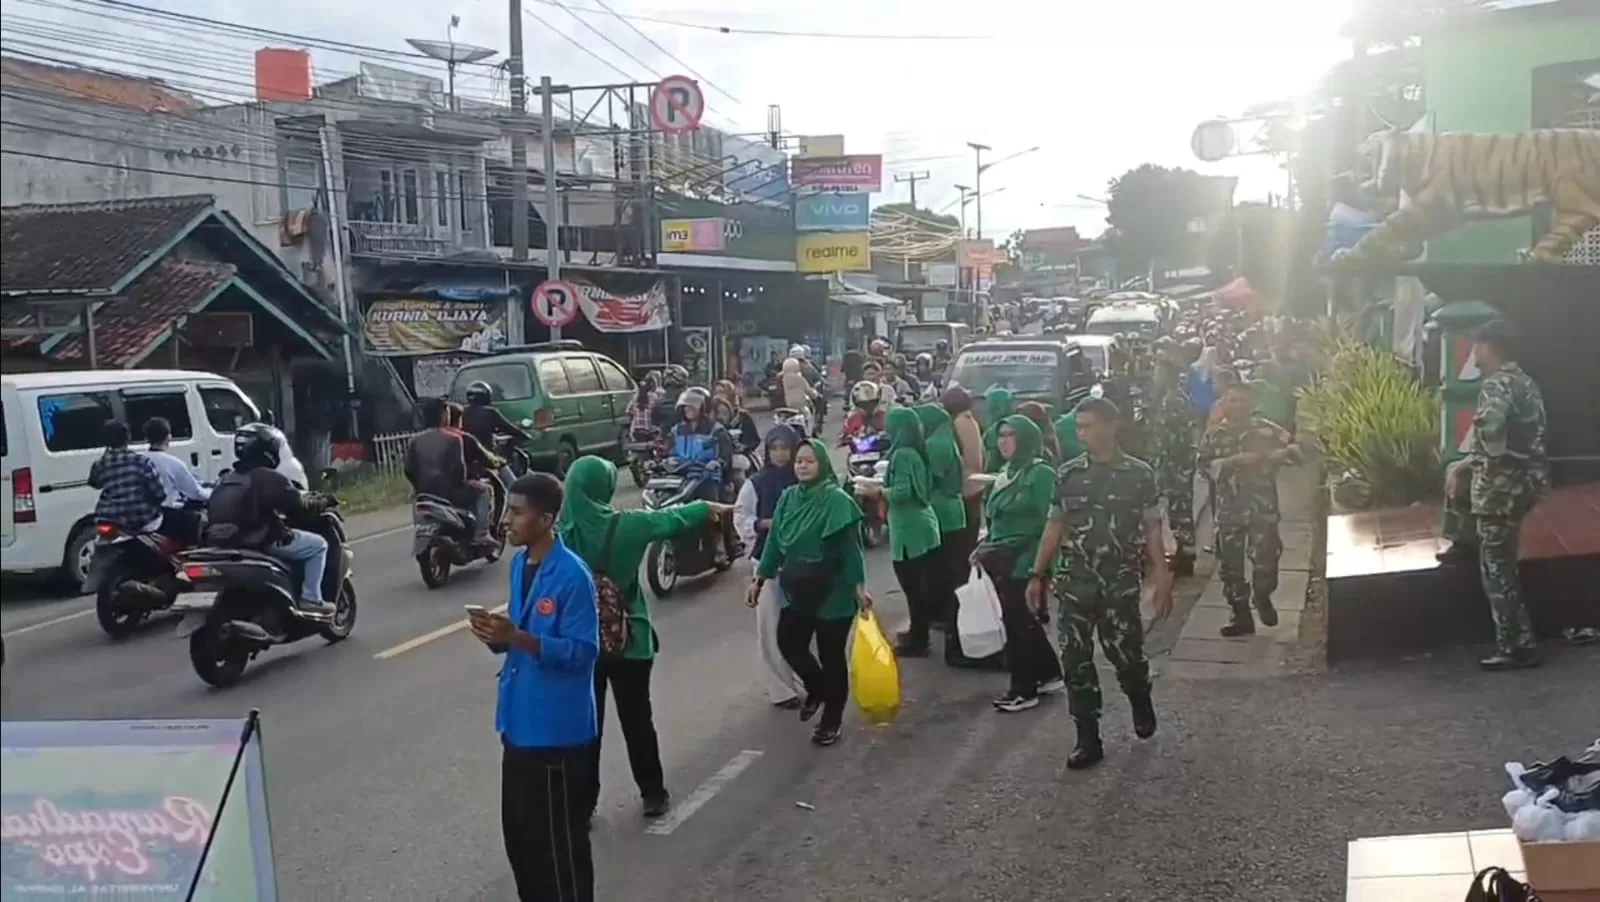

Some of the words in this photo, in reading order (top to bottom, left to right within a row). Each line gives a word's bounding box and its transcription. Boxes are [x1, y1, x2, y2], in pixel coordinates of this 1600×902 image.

[805, 244, 859, 260] realme
[371, 310, 429, 321] KURNIA
[436, 310, 488, 321] DJAYA
